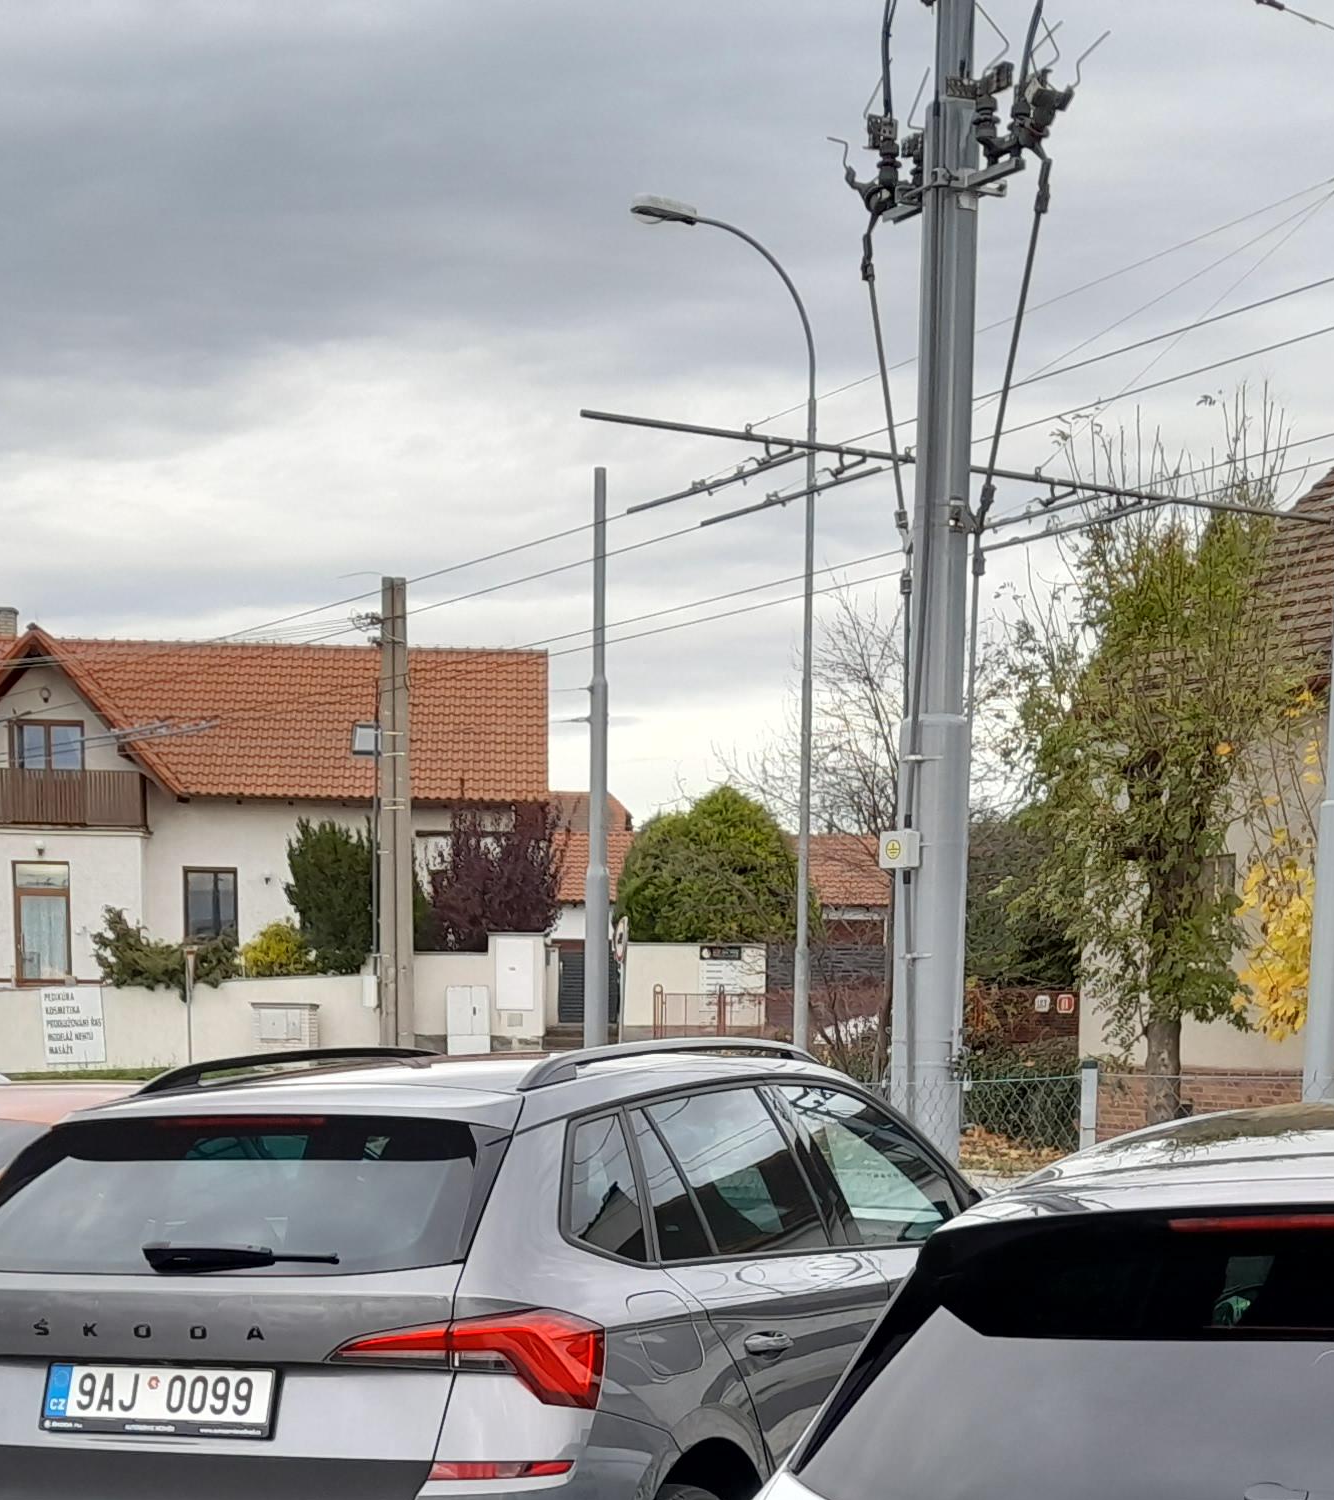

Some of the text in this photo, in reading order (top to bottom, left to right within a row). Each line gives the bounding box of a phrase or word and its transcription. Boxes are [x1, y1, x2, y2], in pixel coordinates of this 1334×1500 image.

[33, 1318, 265, 1341] ŠKODA
[49, 1398, 66, 1411] CZ
[76, 1372, 254, 1415] 9AJ 0099
